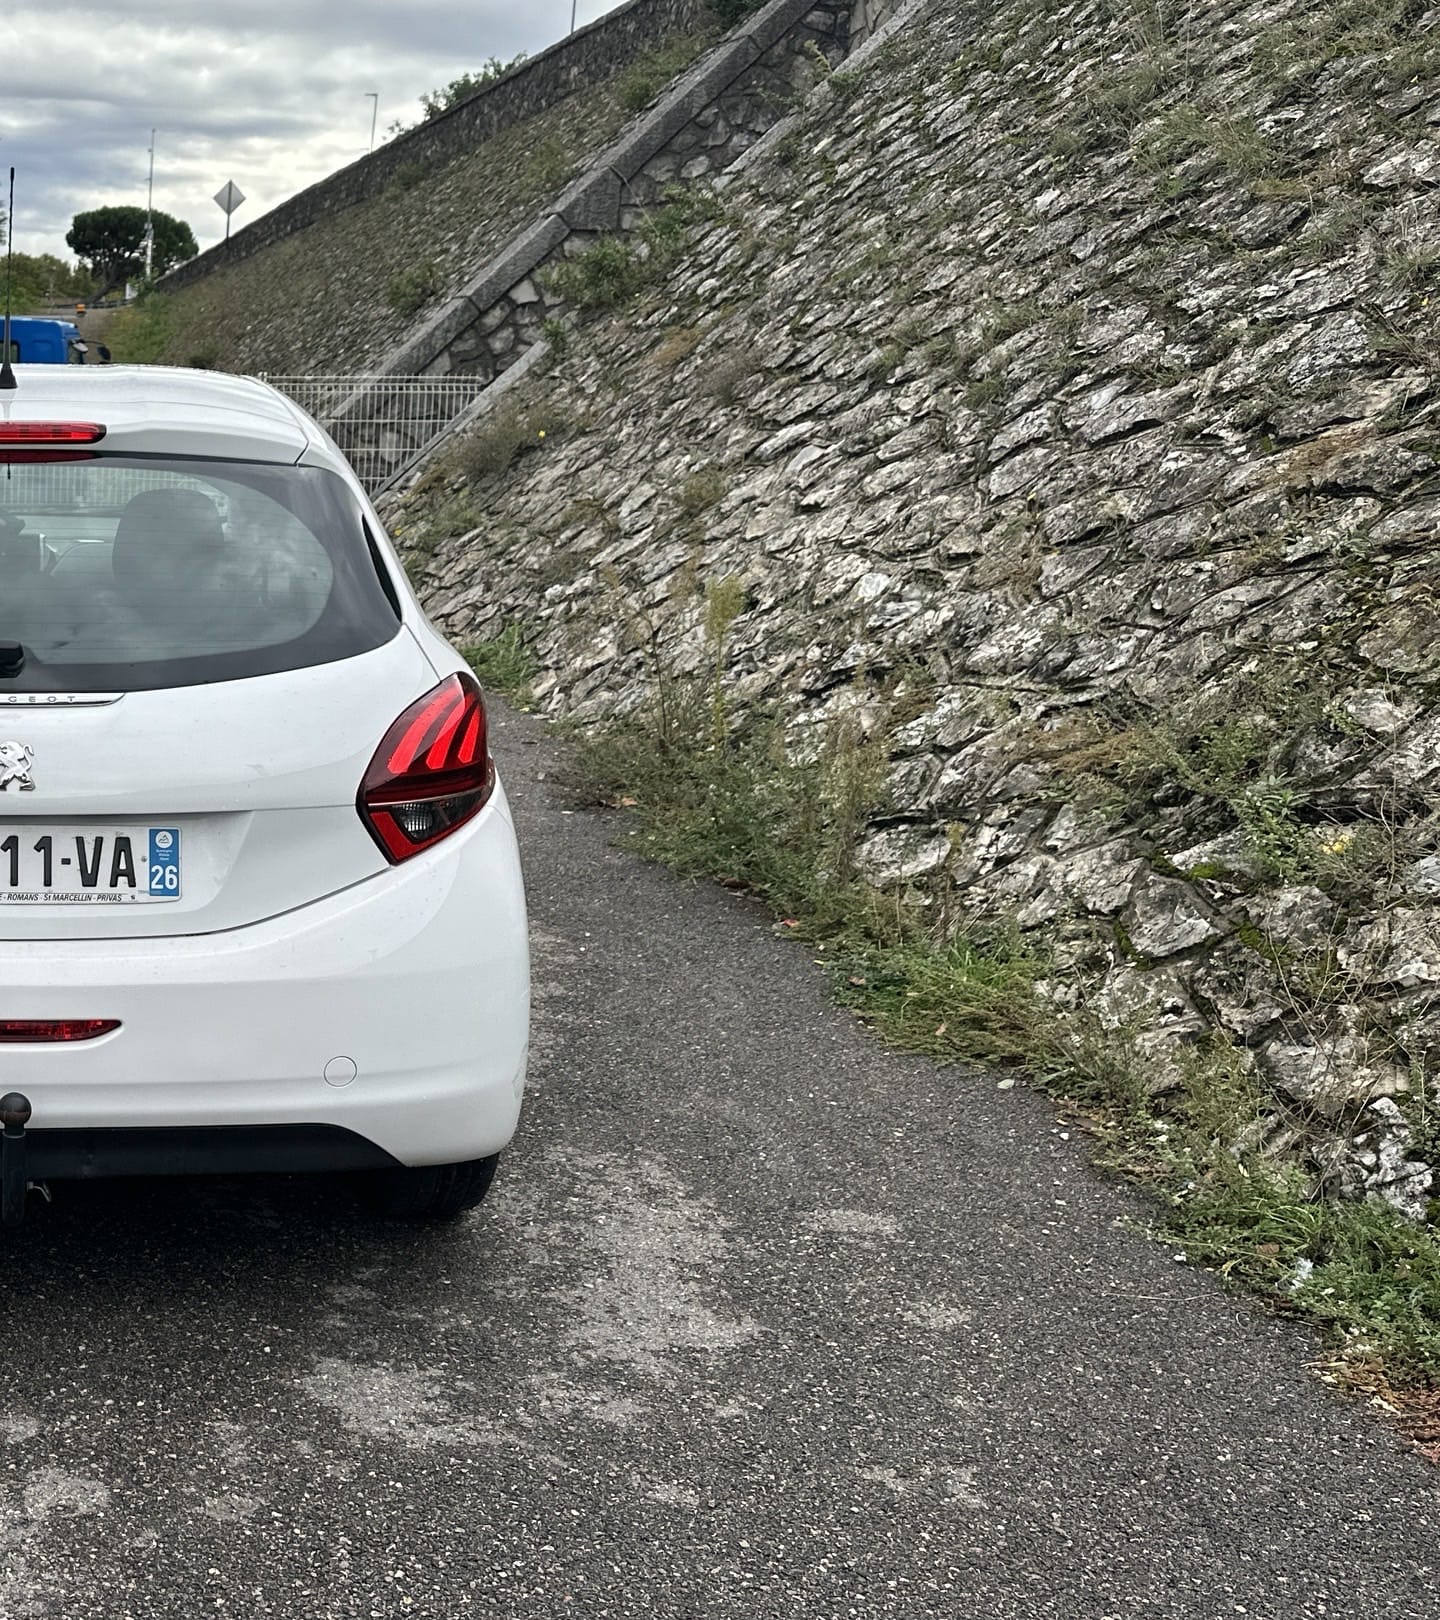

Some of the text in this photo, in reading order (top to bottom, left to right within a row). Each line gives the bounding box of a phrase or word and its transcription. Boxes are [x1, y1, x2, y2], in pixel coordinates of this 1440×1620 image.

[151, 864, 178, 890] 26
[7, 893, 39, 902] ROMANS
[52, 893, 92, 902] MARCELLIN
[96, 894, 122, 903] PRIVAS
